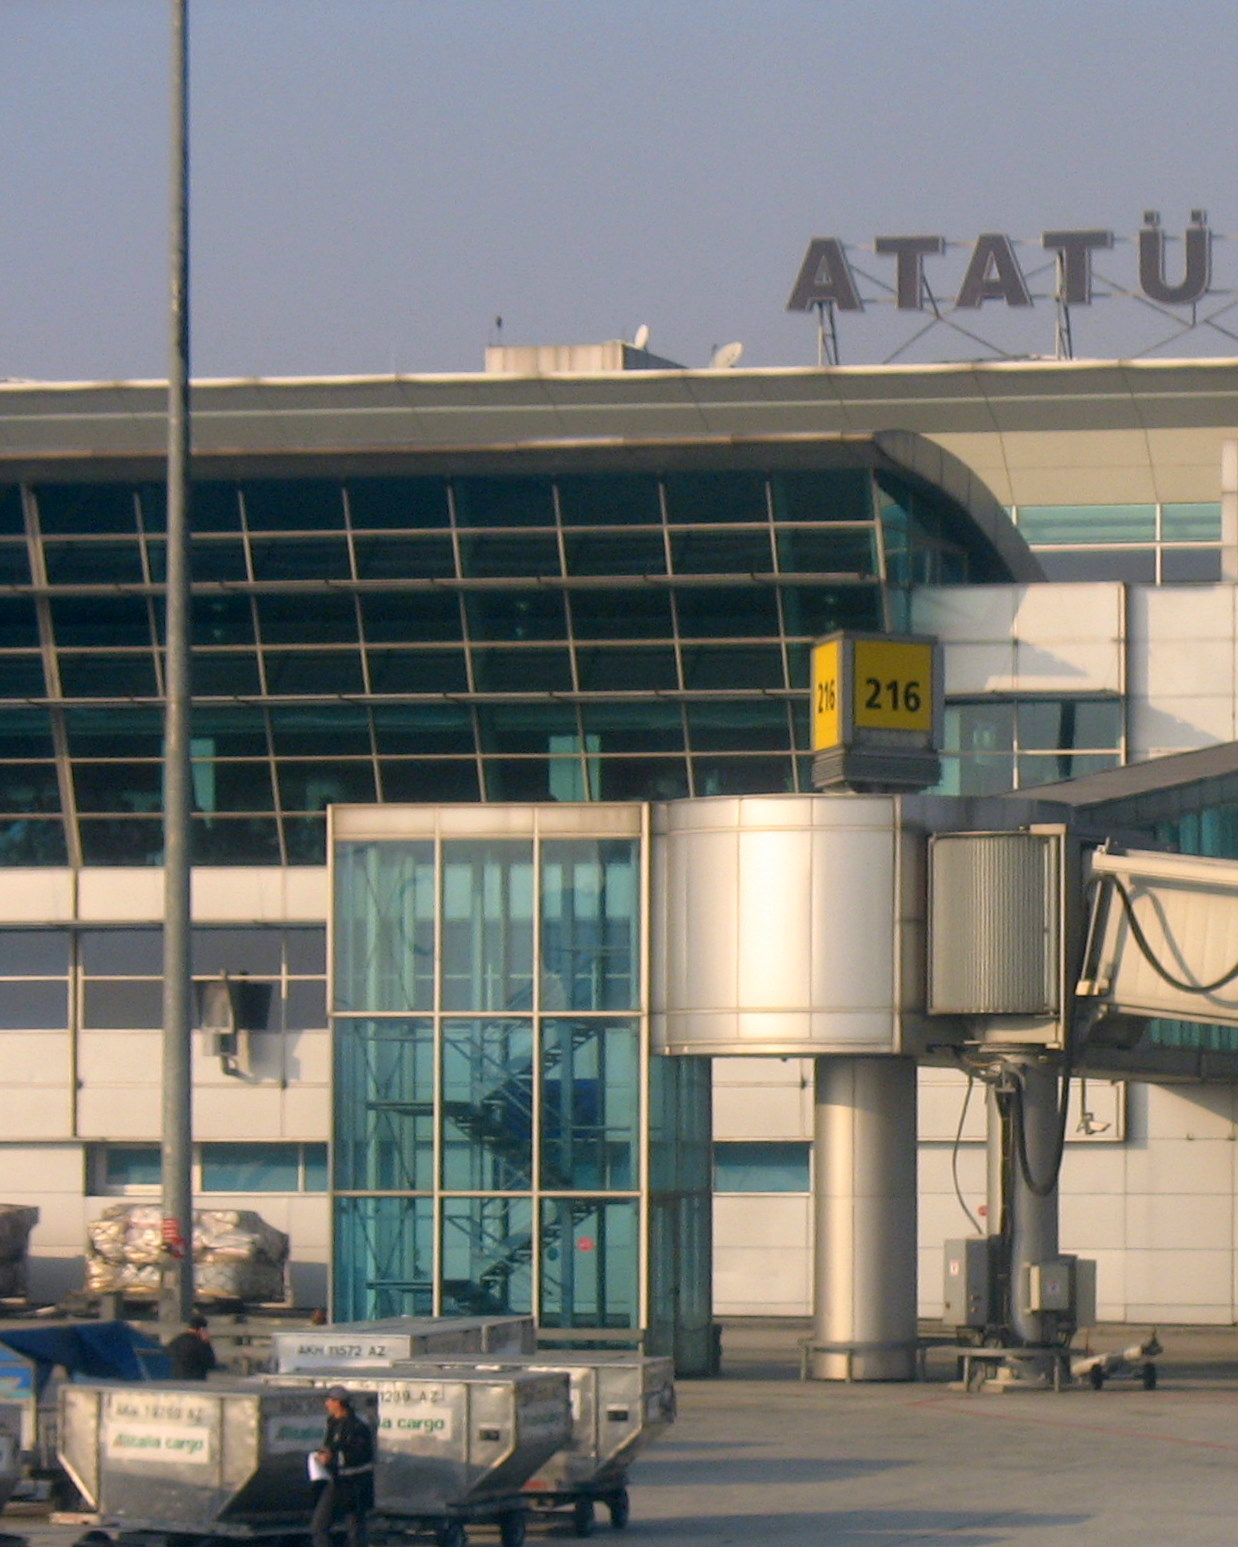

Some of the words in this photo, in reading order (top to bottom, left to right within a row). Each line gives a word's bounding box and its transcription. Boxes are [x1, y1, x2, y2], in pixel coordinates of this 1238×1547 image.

[817, 680, 836, 714] 216
[864, 677, 922, 713] 216
[368, 1344, 387, 1357] AZ
[397, 1417, 446, 1432] cargo
